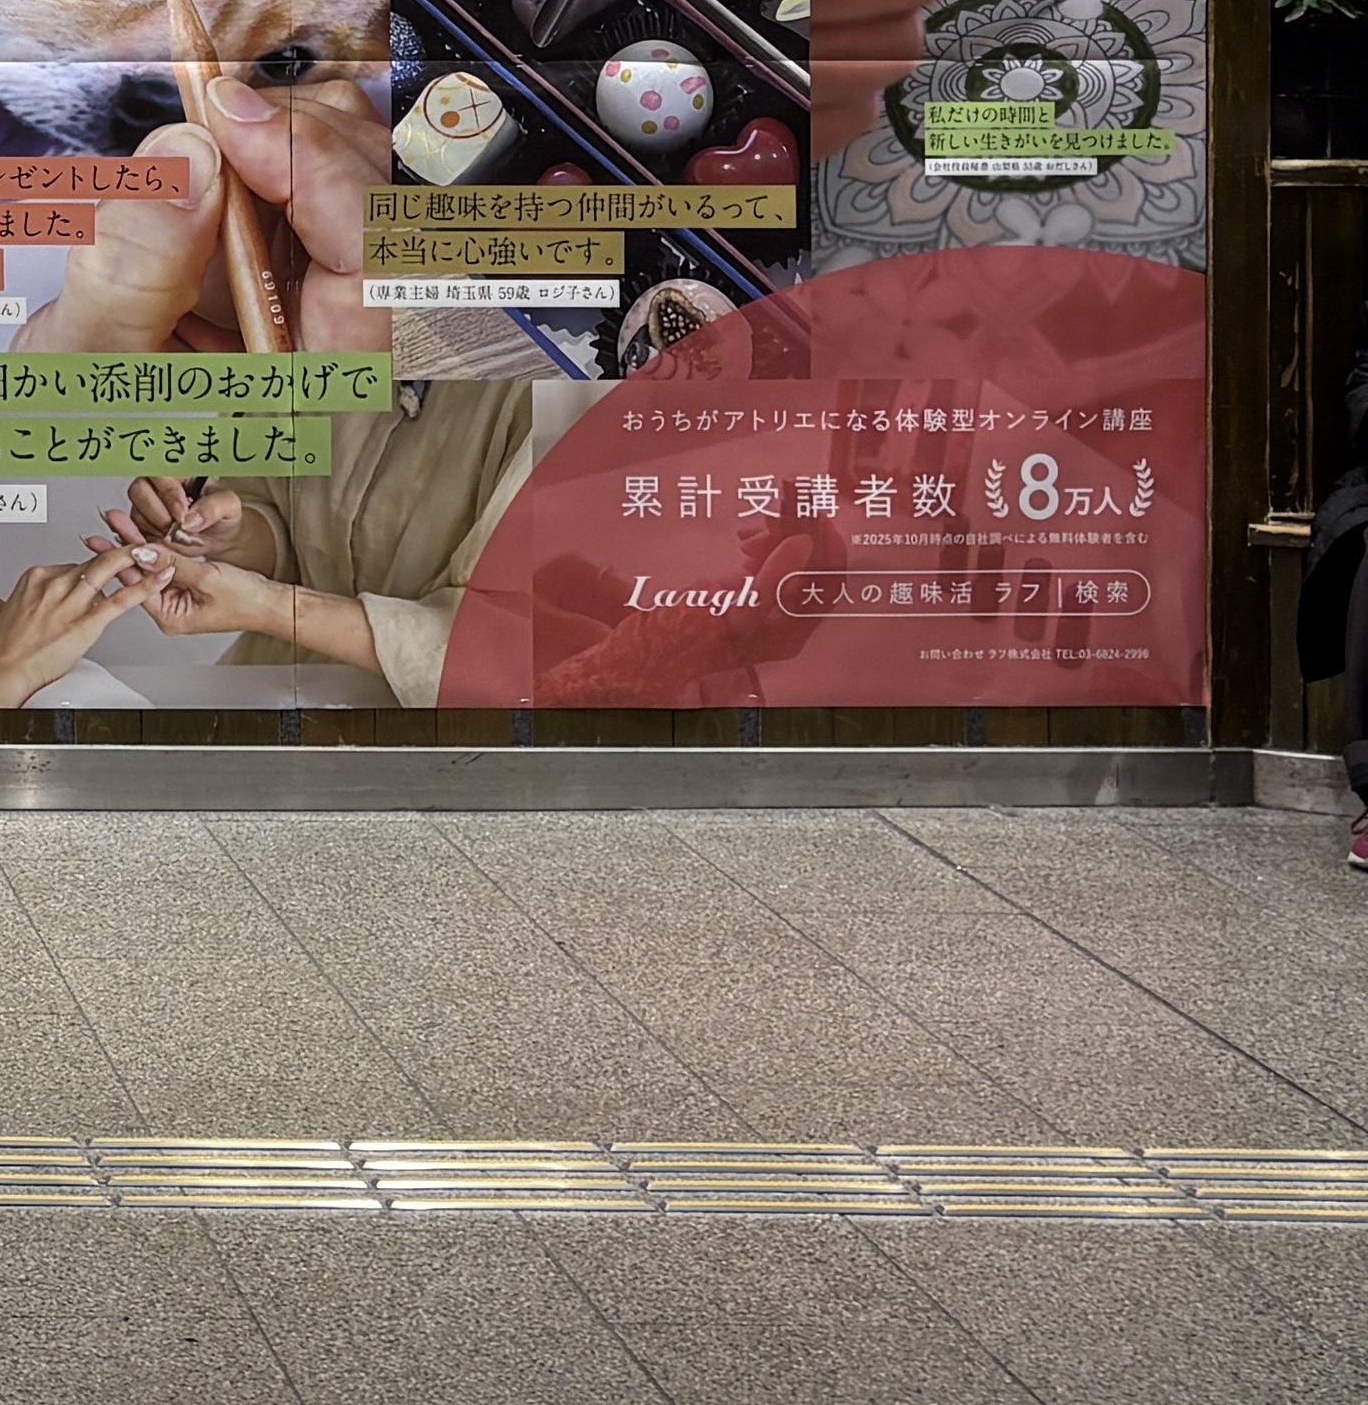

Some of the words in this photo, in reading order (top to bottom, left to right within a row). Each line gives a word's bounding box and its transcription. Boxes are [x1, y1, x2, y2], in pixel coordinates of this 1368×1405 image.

[929, 106, 1049, 124] 私だけの時間と
[929, 134, 1171, 151] 新しい生きがいを見つけました。
[369, 192, 784, 221] 同じ趣味を持つ仲間がいるって、
[369, 236, 615, 266] 本当に心強いです。
[445, 285, 492, 301] 埼玉県
[623, 408, 1153, 432] おうちがアトリエになる体験型オンライン講座
[623, 474, 956, 519] 累計受講者数
[1019, 453, 1122, 520] 8万人
[624, 575, 759, 616] Laugh
[802, 583, 972, 605] 大人の趣味活
[996, 583, 1041, 604] ラフ
[1075, 581, 1129, 605] 検索
